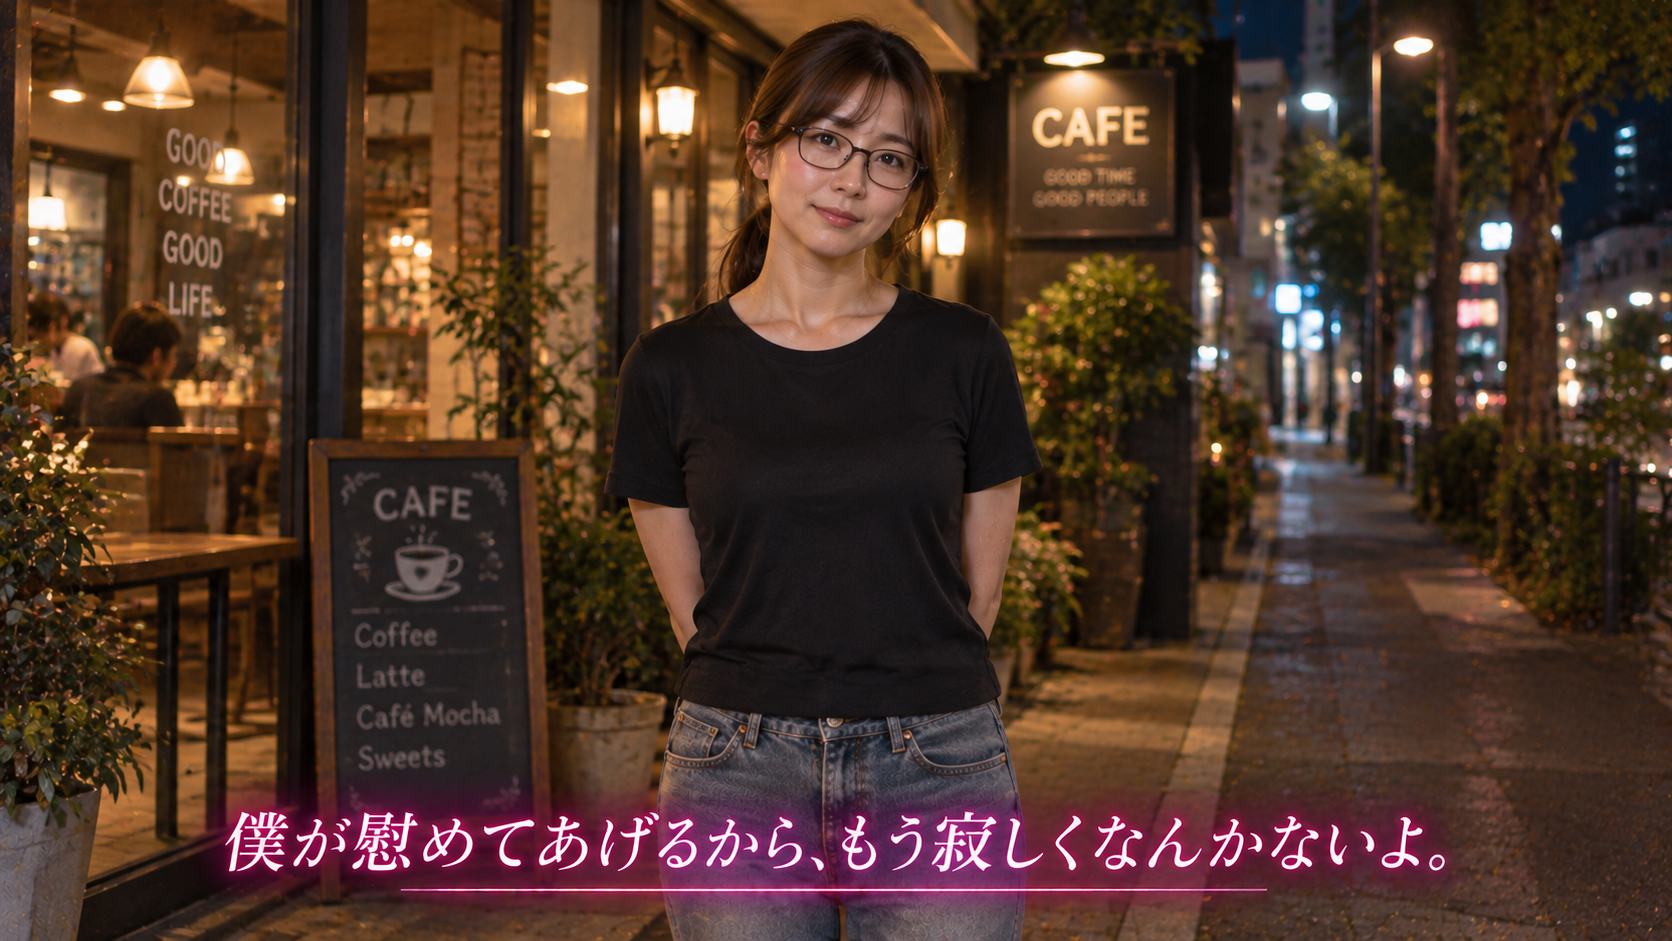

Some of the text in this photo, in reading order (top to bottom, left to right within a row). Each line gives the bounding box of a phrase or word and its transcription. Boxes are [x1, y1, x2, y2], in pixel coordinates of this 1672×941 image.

[1031, 105, 1151, 149] CAFE
[1043, 166, 1137, 187] GOOD TIME
[158, 178, 233, 224] COFFEE
[1032, 188, 1150, 208] GOOD PEOPLE
[163, 229, 224, 270] GOOD
[168, 280, 213, 318] LIFE
[373, 485, 474, 522] CAFE
[354, 621, 438, 649] Coffee
[356, 663, 427, 690] Latte
[356, 700, 502, 731] Café Mocha
[358, 744, 447, 772] Sweets
